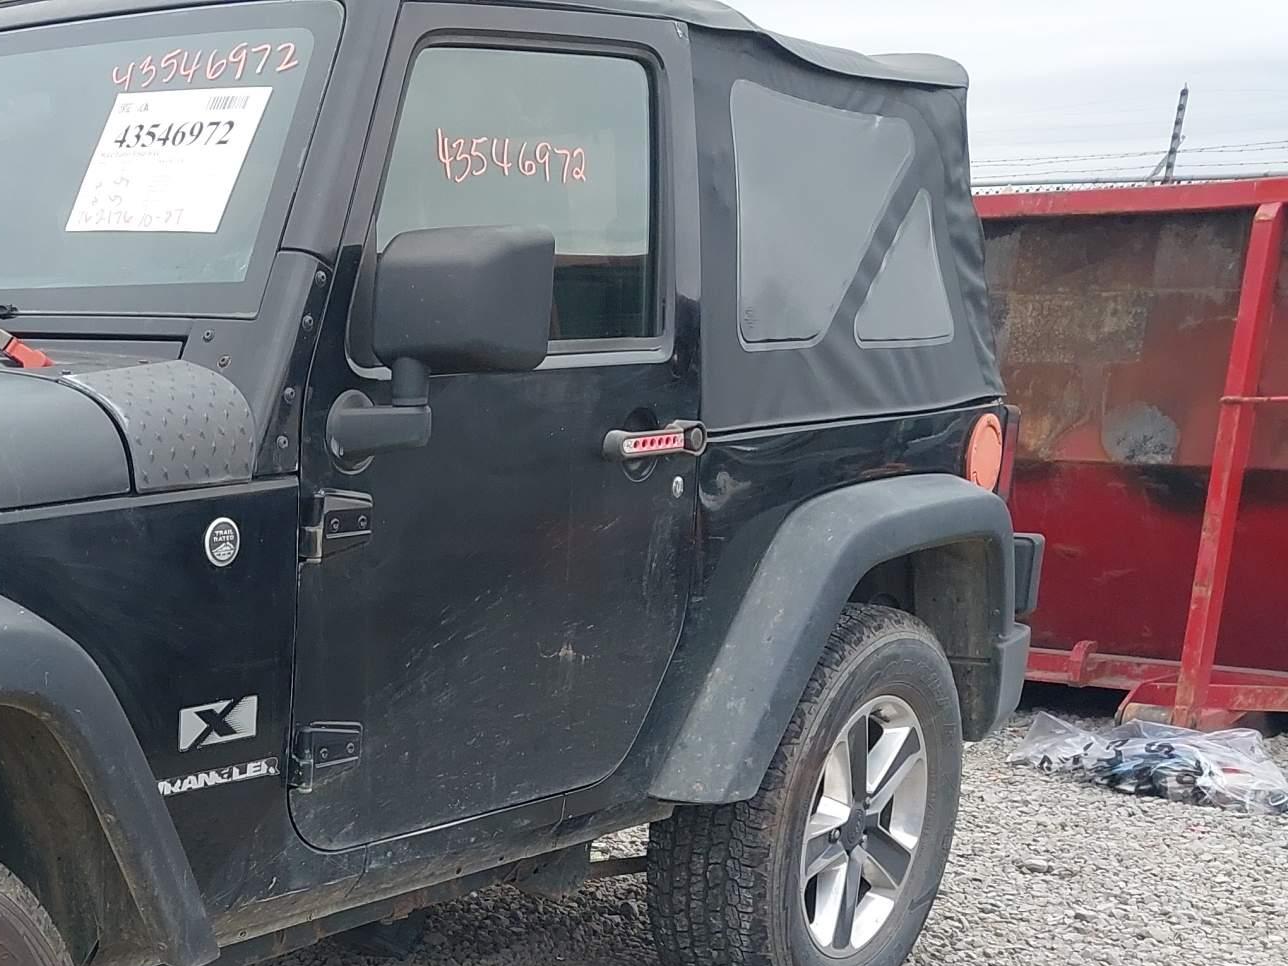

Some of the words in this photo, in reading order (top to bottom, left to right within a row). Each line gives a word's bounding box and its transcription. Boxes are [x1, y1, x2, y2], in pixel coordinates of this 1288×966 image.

[113, 42, 299, 90] 43546972
[114, 119, 235, 149] 43546972
[436, 127, 586, 183] 43546972
[213, 528, 234, 537] TRAIL
[213, 534, 235, 543] RATED
